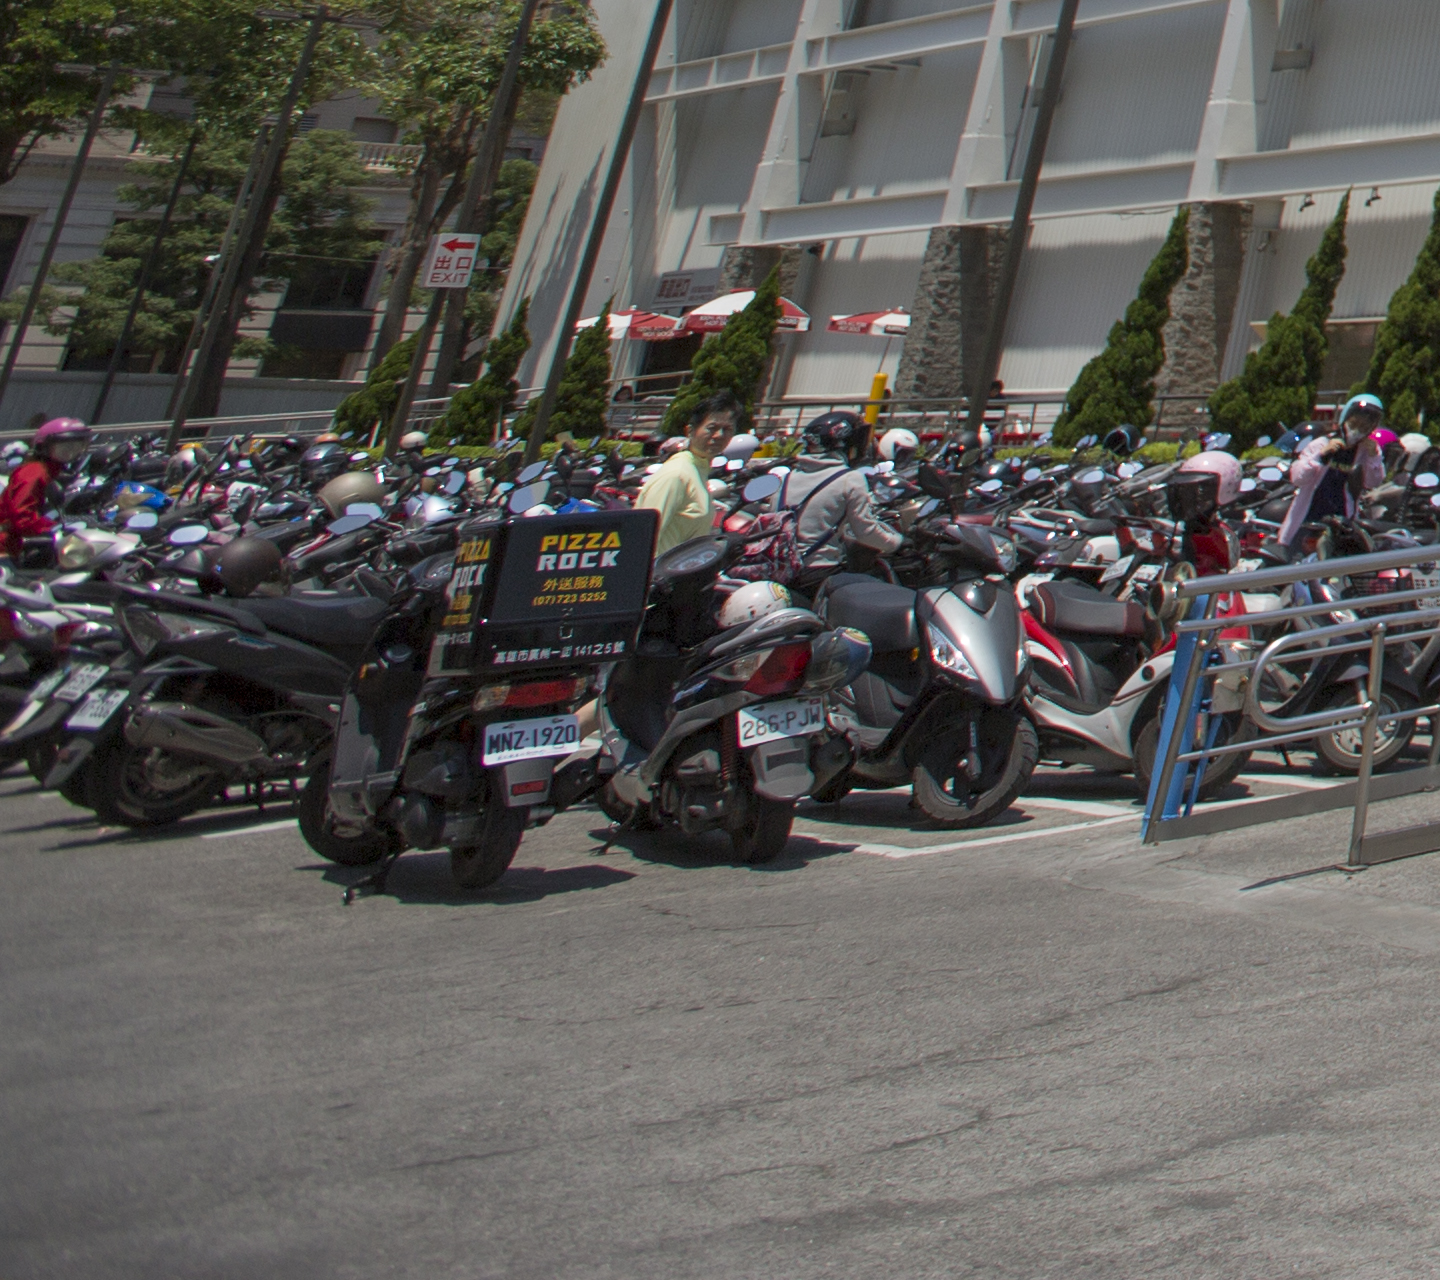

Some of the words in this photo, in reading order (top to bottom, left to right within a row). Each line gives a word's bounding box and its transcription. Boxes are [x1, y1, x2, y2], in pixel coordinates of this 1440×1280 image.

[434, 255, 472, 270] 出口
[430, 272, 468, 283] EXIT
[539, 531, 622, 552] PIZZA
[457, 540, 490, 561] PIZZA
[536, 550, 619, 572] ROCK
[542, 575, 604, 591] 外送服務
[580, 592, 607, 603] 5252
